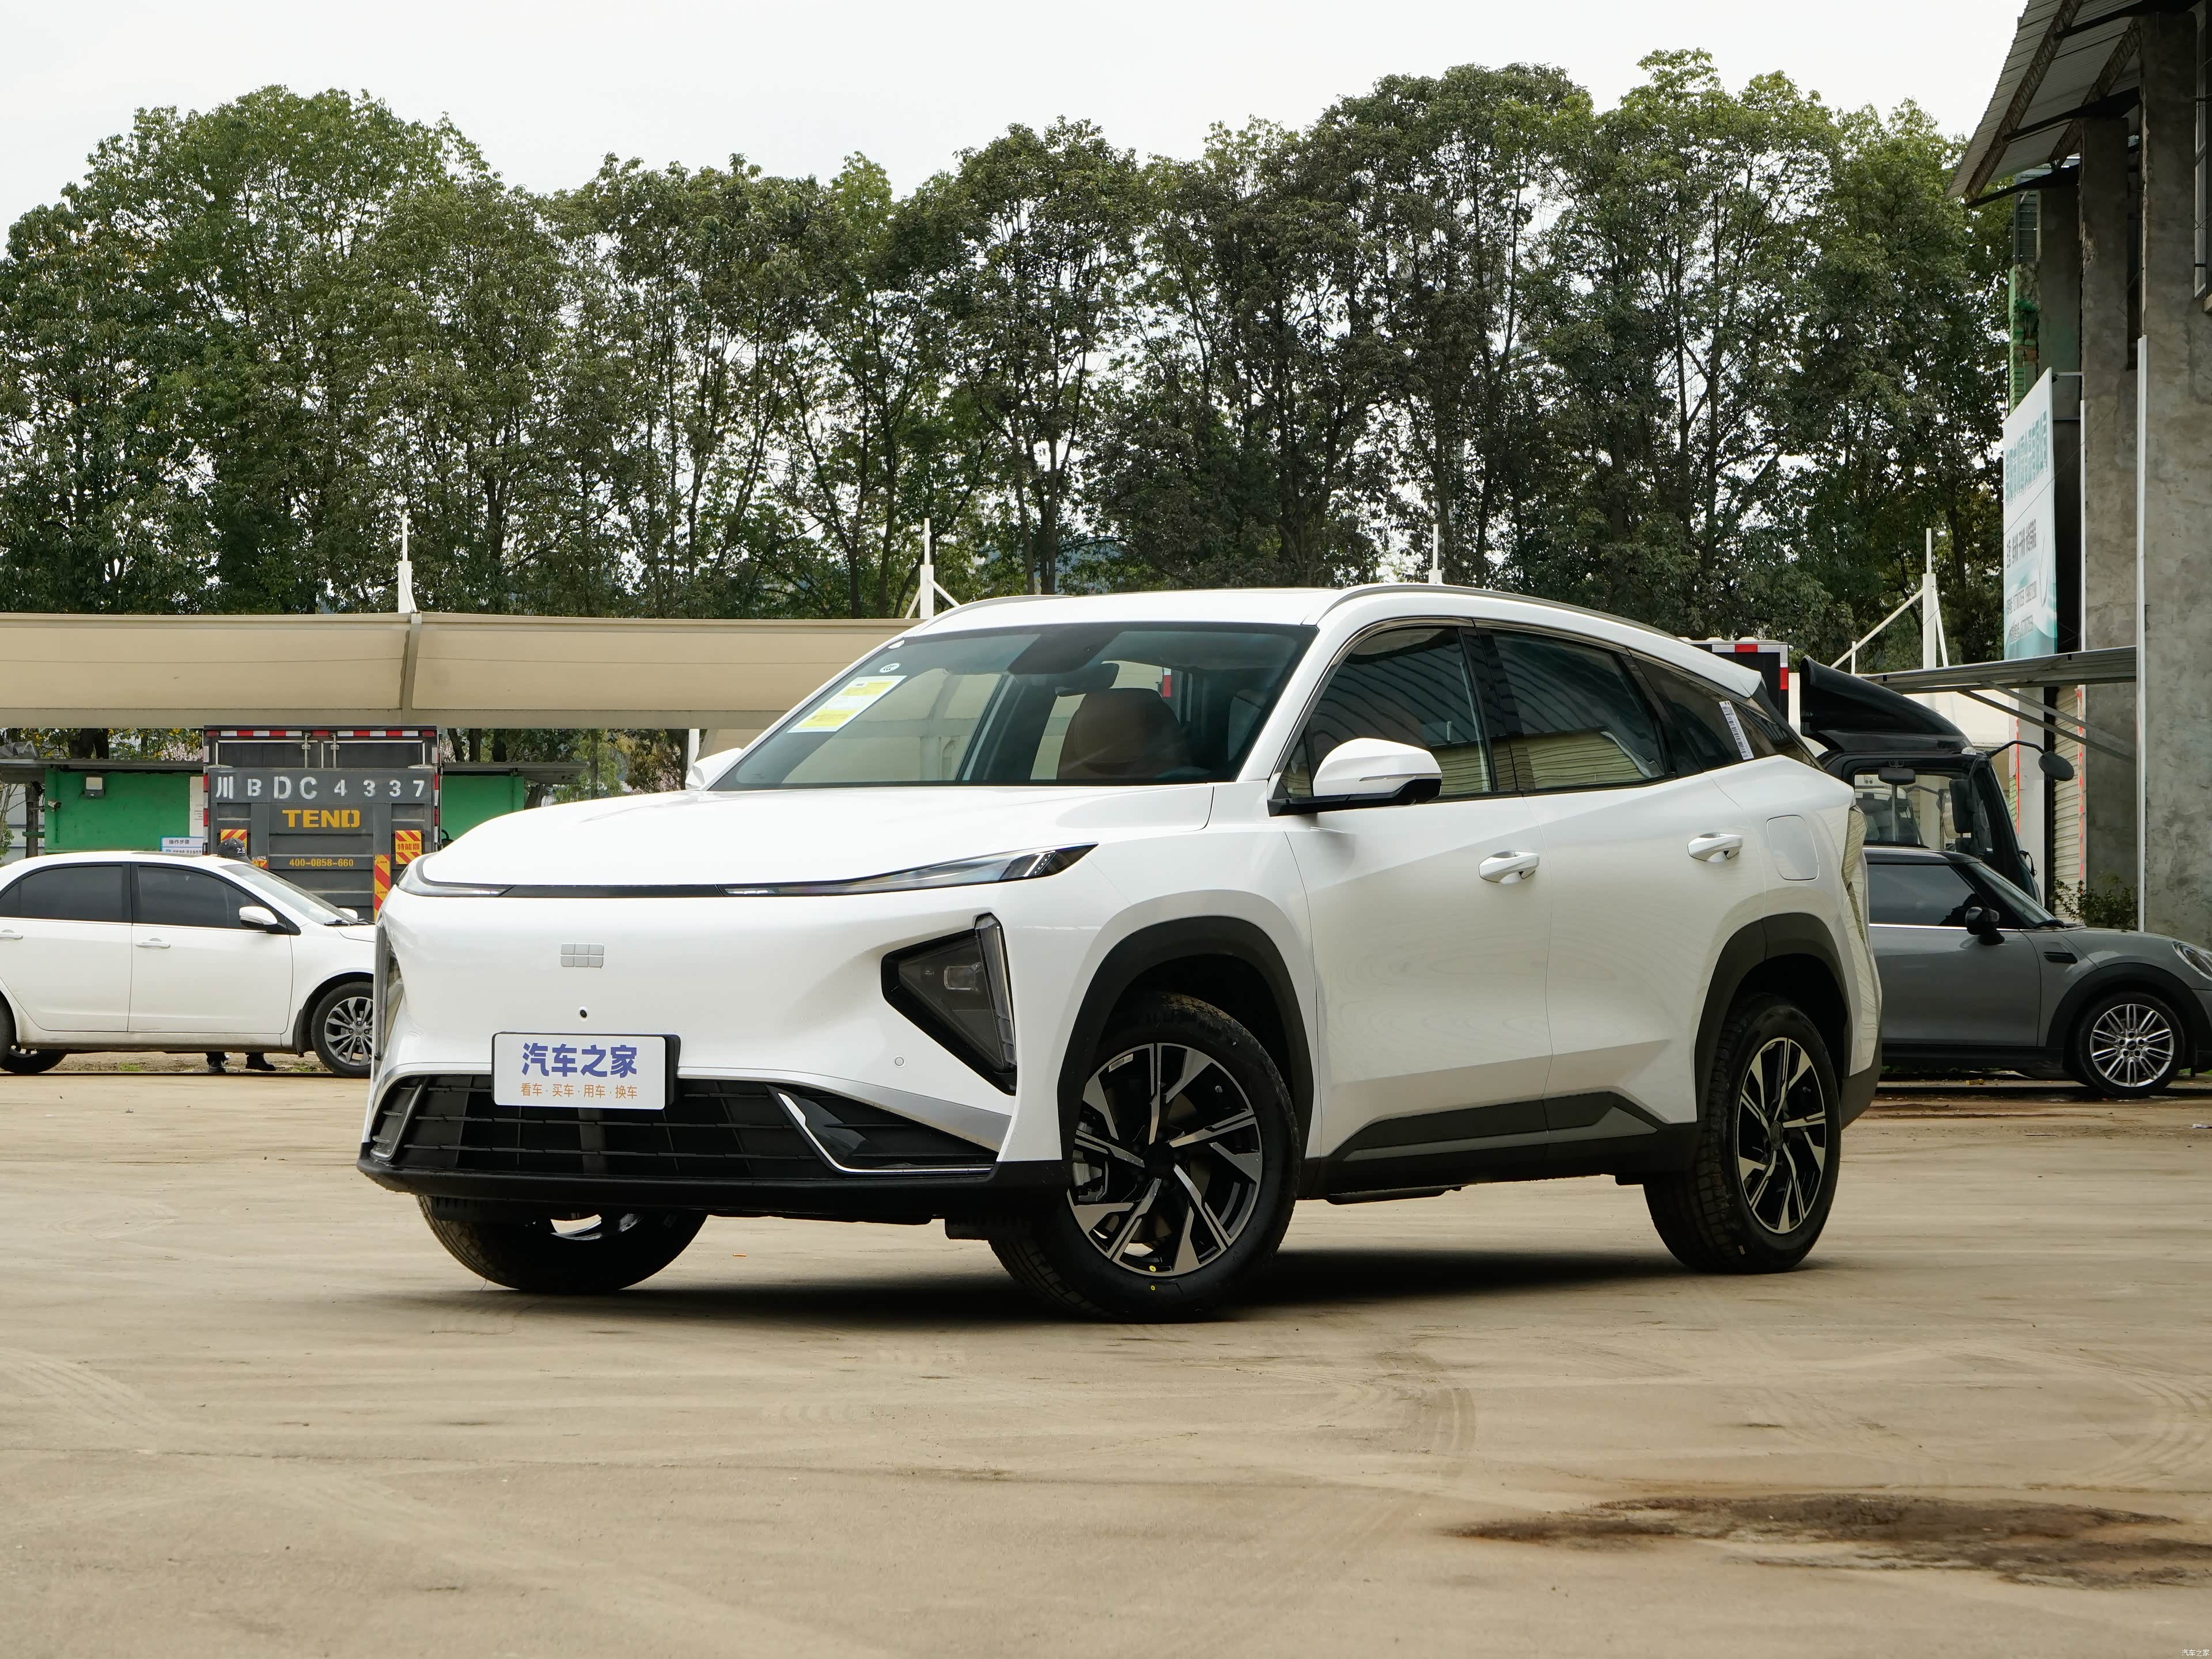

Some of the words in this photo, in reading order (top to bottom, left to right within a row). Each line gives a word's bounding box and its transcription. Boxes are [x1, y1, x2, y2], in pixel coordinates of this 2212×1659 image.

[282, 809, 361, 828] TEND
[289, 858, 354, 867] 400-0858-660
[522, 1043, 637, 1078] 汽车之家
